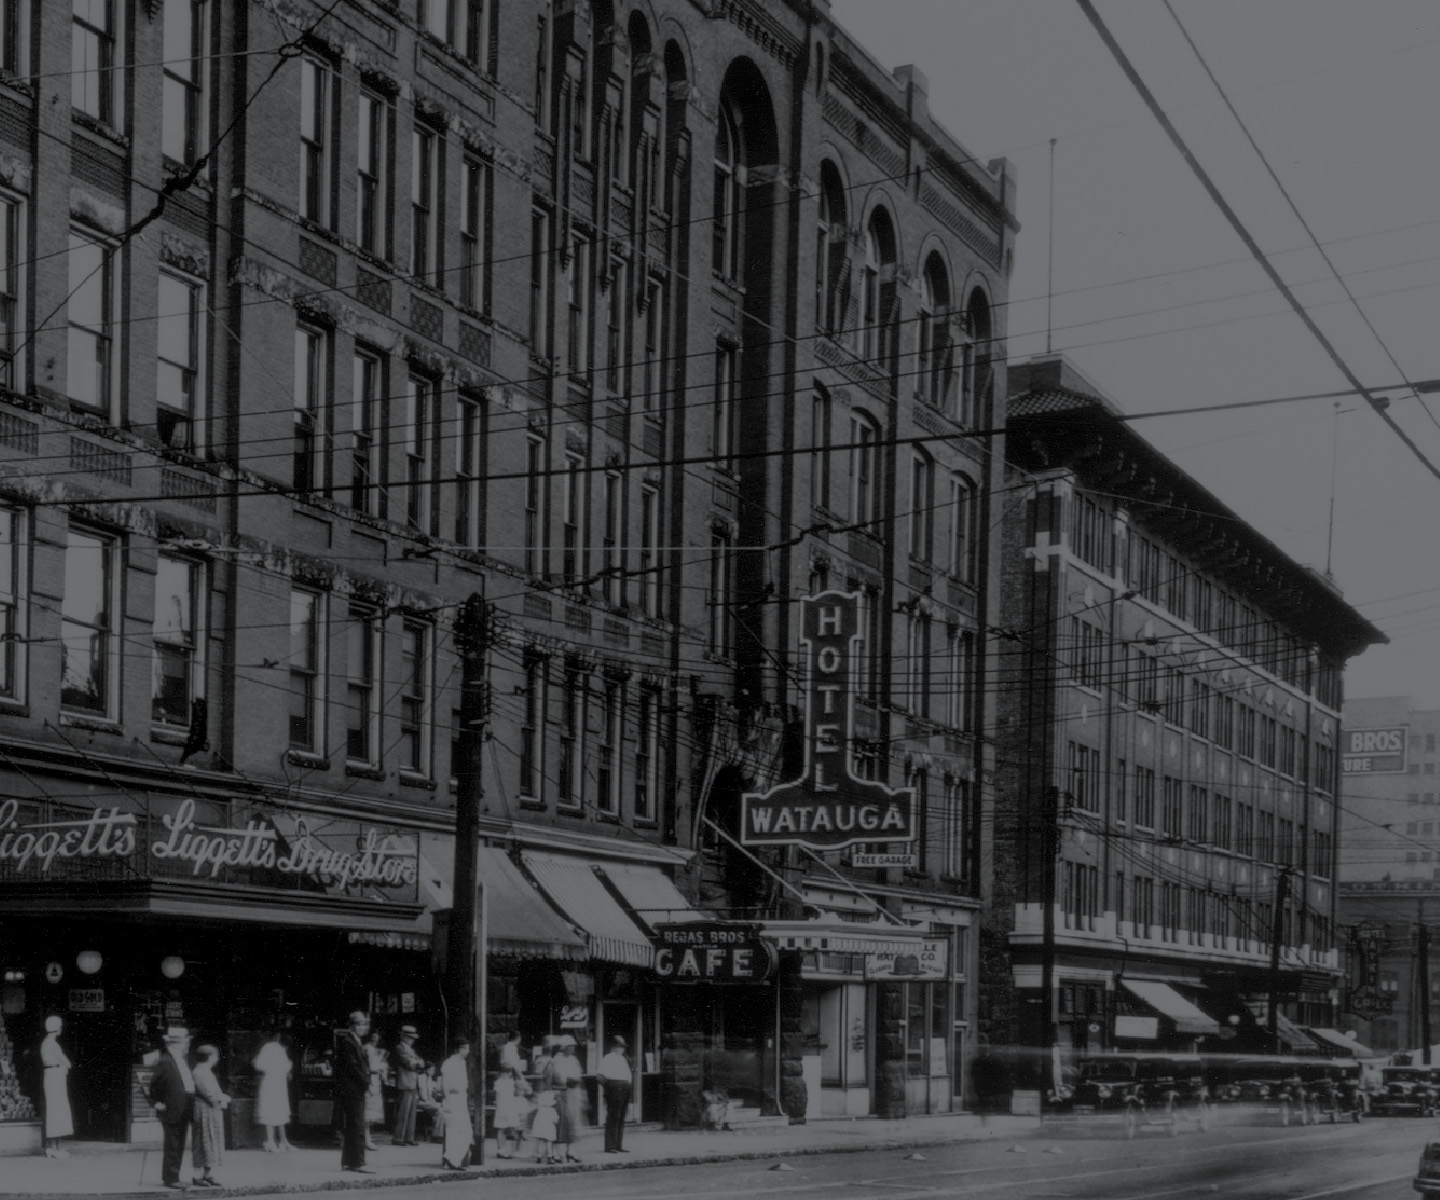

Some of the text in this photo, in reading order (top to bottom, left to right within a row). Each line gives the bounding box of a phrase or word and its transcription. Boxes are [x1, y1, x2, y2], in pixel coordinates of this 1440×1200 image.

[815, 606, 842, 792] HOTEL
[751, 804, 906, 833] WATAUGA
[152, 798, 417, 890] Liggett's Drug Store
[856, 855, 876, 864] FREE
[656, 948, 753, 976] CAFE
